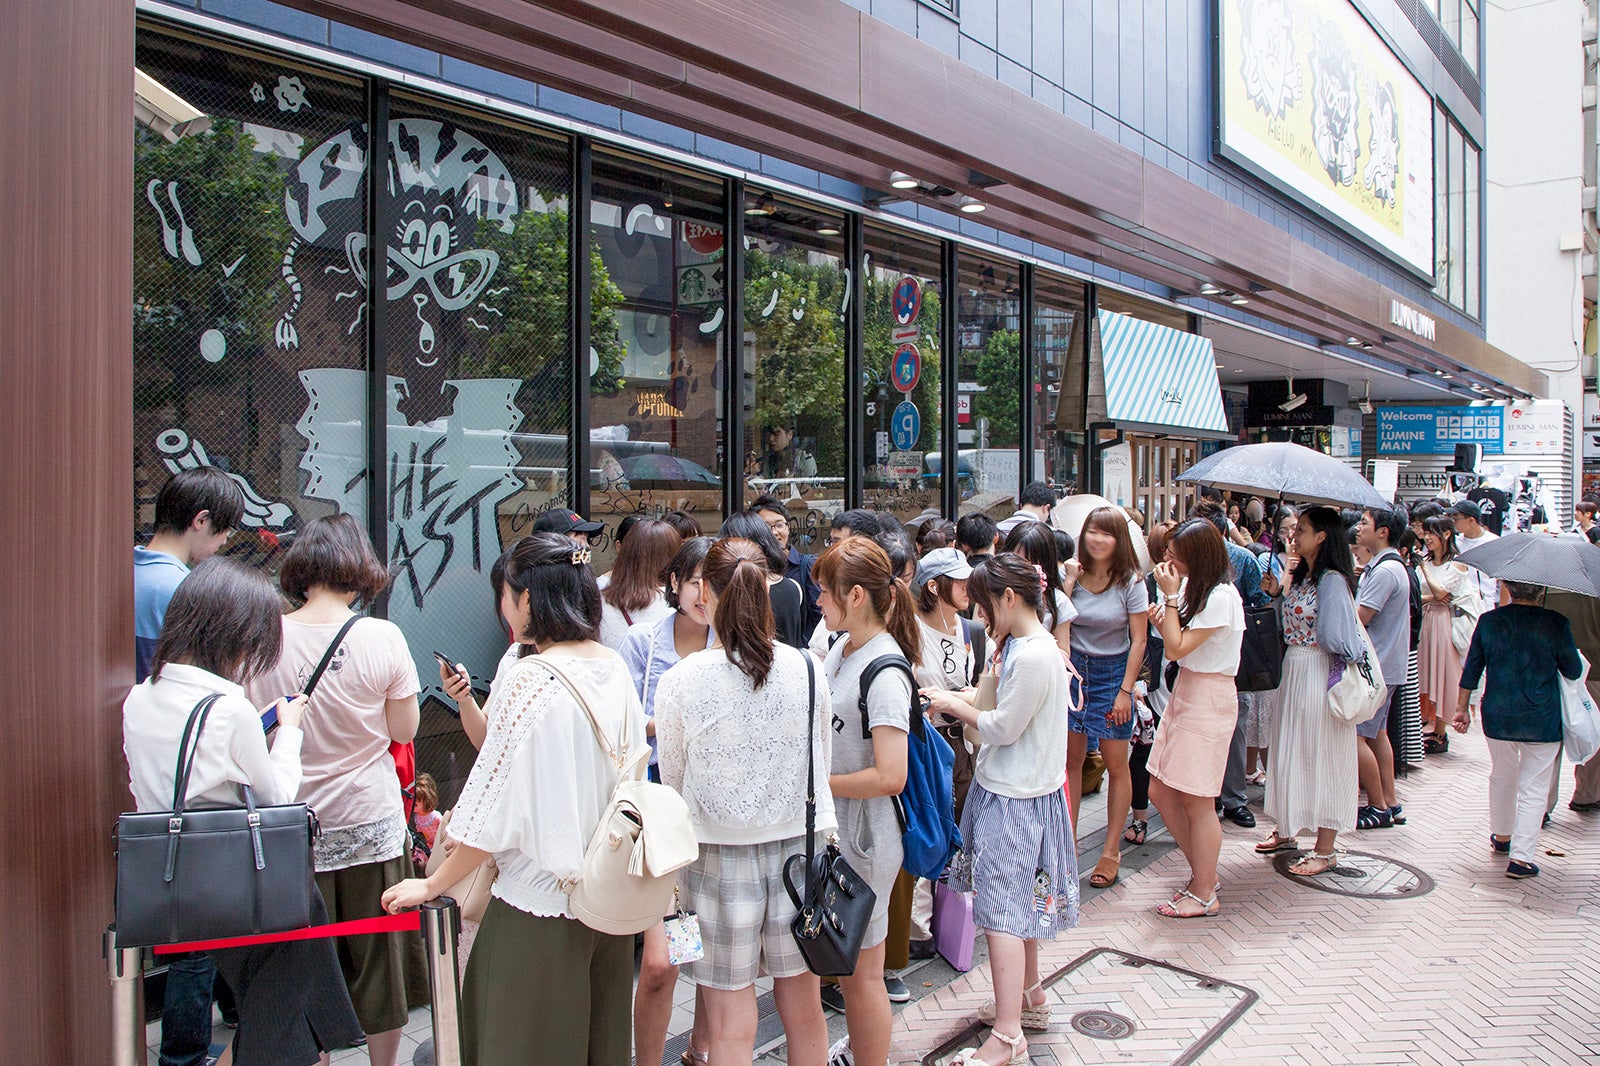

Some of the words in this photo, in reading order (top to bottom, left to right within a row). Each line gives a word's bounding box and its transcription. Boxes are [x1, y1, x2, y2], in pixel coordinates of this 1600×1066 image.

[1263, 413, 1292, 421] LUMINE
[1293, 412, 1313, 420] MAN
[1380, 411, 1434, 421] Welcome
[1381, 422, 1393, 431] to
[1507, 424, 1537, 432] LUMINE
[1381, 431, 1425, 441] LUMINE
[1381, 441, 1411, 451] MAN
